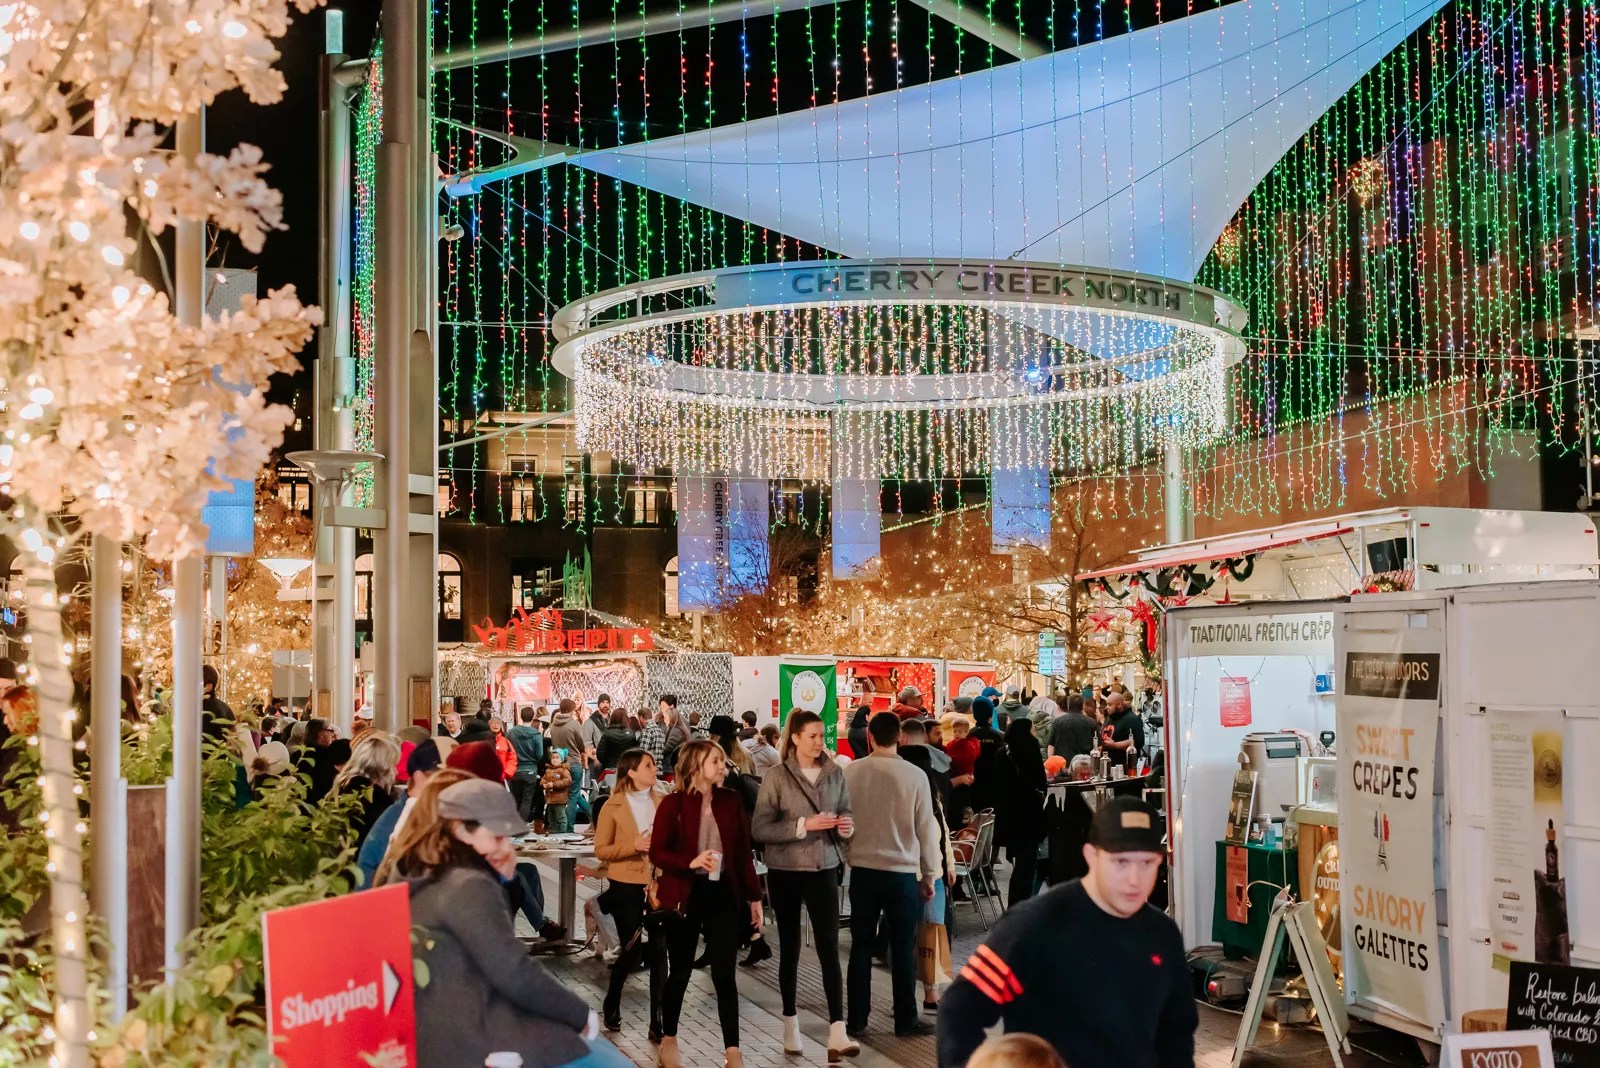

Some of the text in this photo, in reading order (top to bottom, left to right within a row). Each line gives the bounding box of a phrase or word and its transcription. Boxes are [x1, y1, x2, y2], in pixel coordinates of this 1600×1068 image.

[792, 270, 1181, 311] CHERRY CREEK NORTH
[714, 482, 723, 527] CHERRY
[1255, 622, 1299, 642] FRENCH
[1352, 660, 1364, 679] THE
[1384, 661, 1430, 681] OUTDOORS
[1353, 760, 1419, 800] CREPES
[1353, 885, 1426, 935] SAVORY
[1354, 925, 1429, 971] GALETTES
[281, 978, 379, 1030] Shopping
[1525, 972, 1568, 1005] Restore
[1517, 1004, 1536, 1020] with
[1539, 1003, 1591, 1024] Colorado
[1575, 1025, 1597, 1044] CBD
[1470, 1050, 1522, 1068] KYOTO
